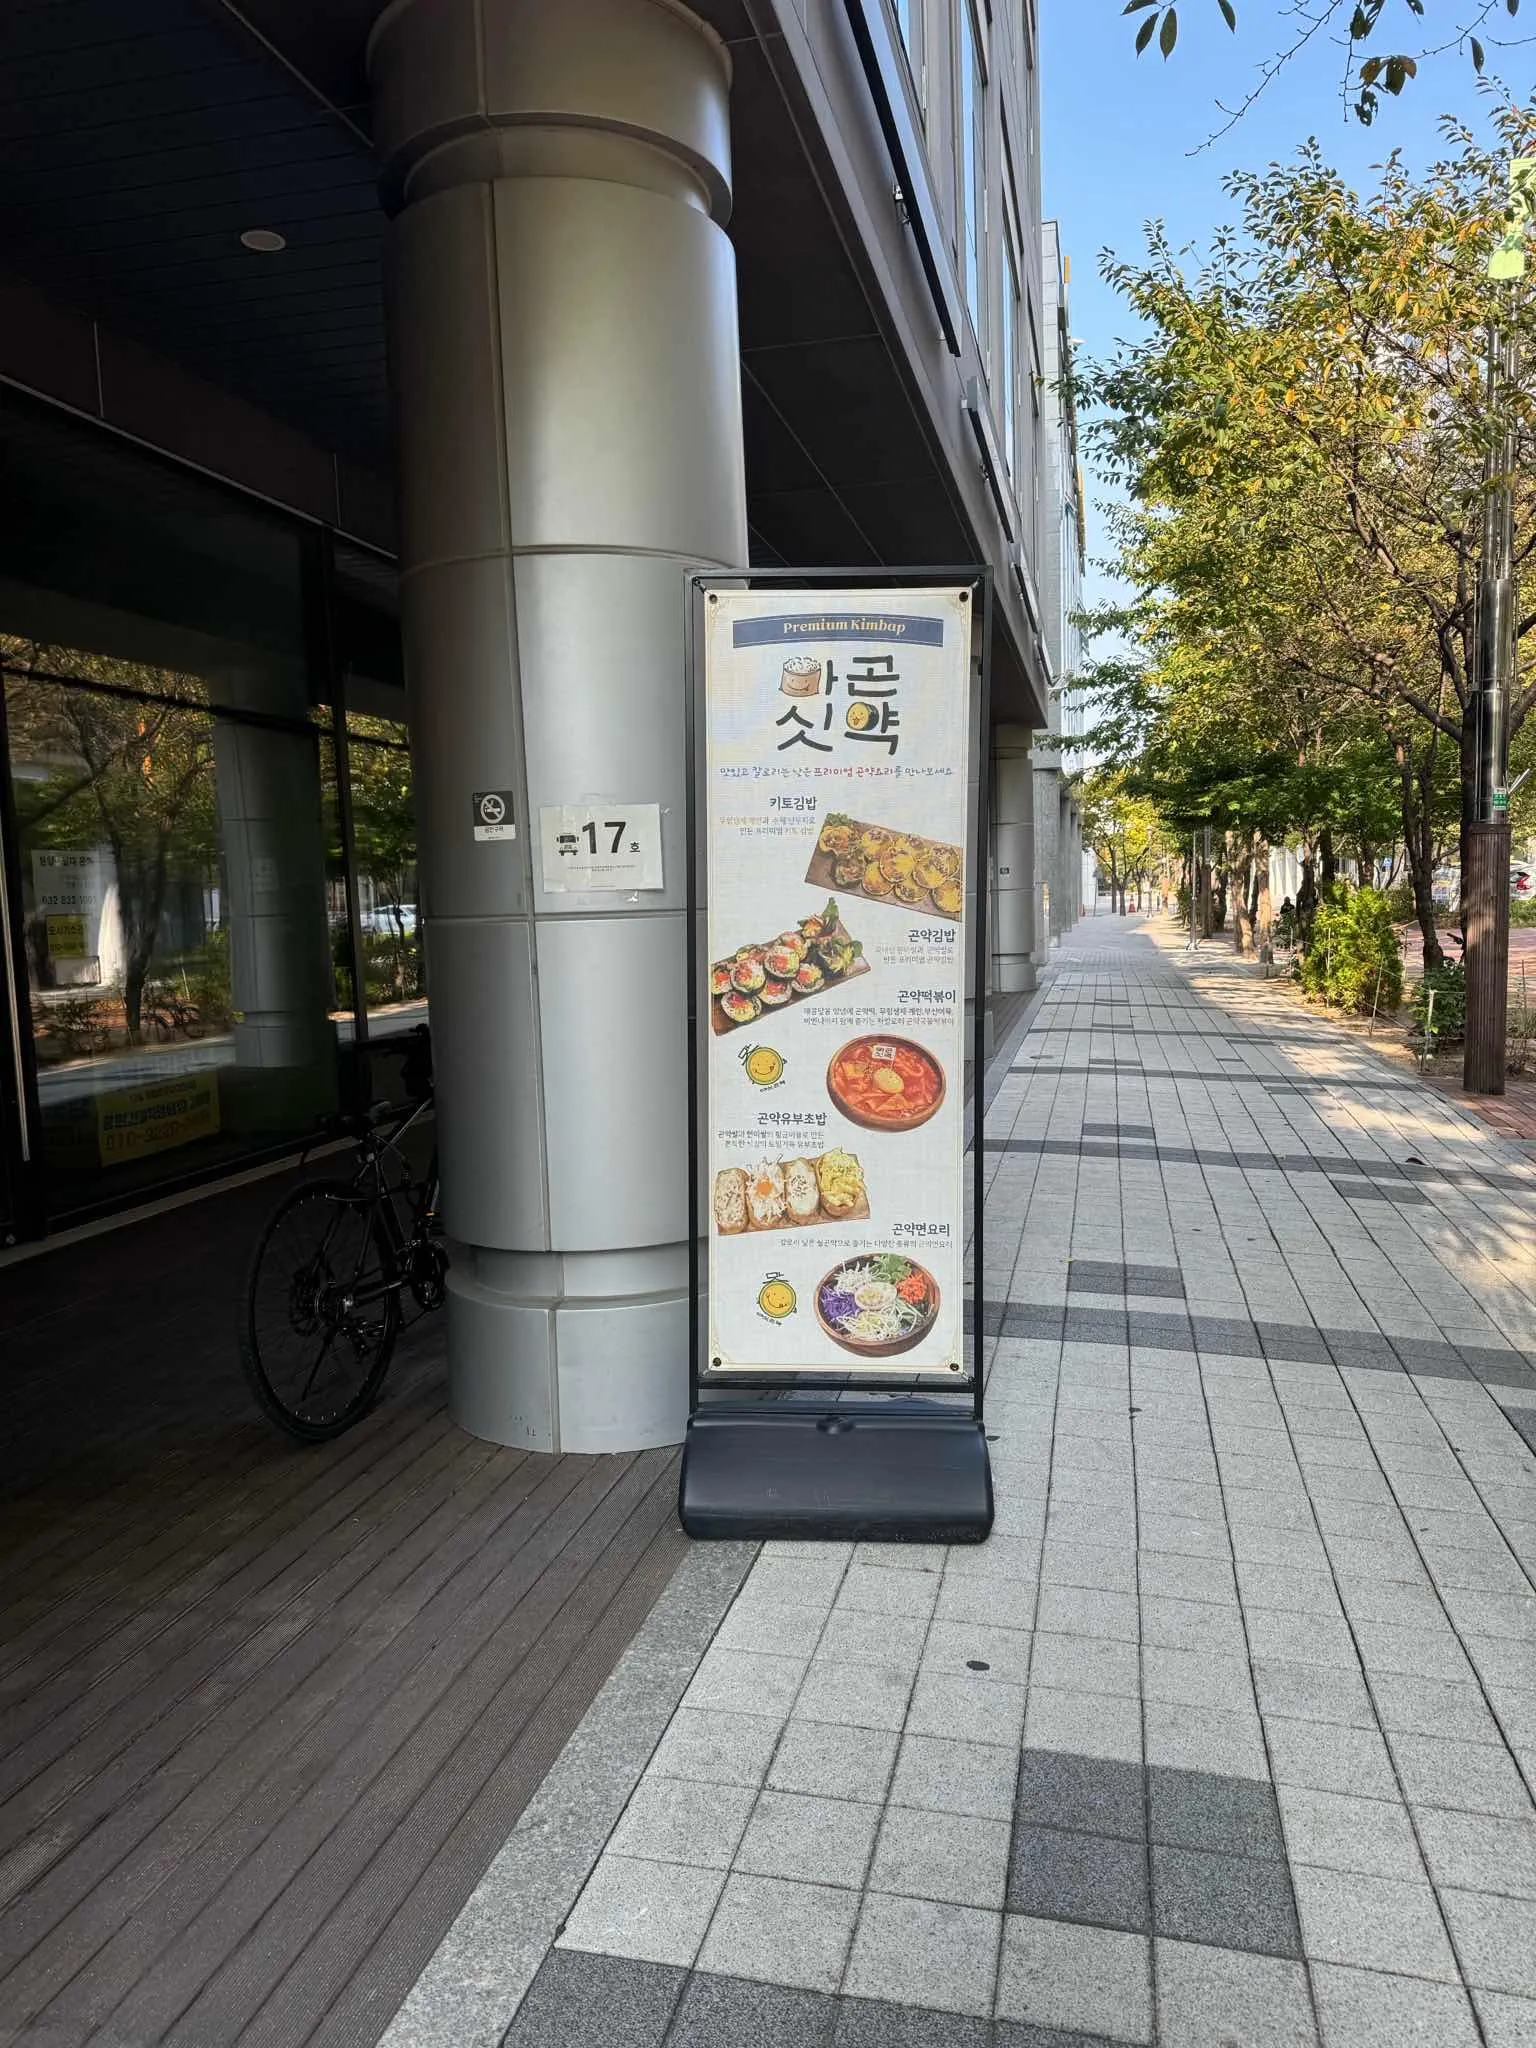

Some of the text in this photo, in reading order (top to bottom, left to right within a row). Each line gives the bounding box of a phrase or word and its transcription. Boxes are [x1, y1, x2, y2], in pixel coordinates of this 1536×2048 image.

[784, 618, 906, 635] Premium Kimbap
[769, 796, 817, 810] 키토김밥
[908, 928, 955, 942] 곤약김밥
[898, 989, 956, 1003] 곤약떡볶이
[757, 1112, 827, 1126] 곤약유부초밥
[892, 1222, 950, 1237] 곤약면요리
